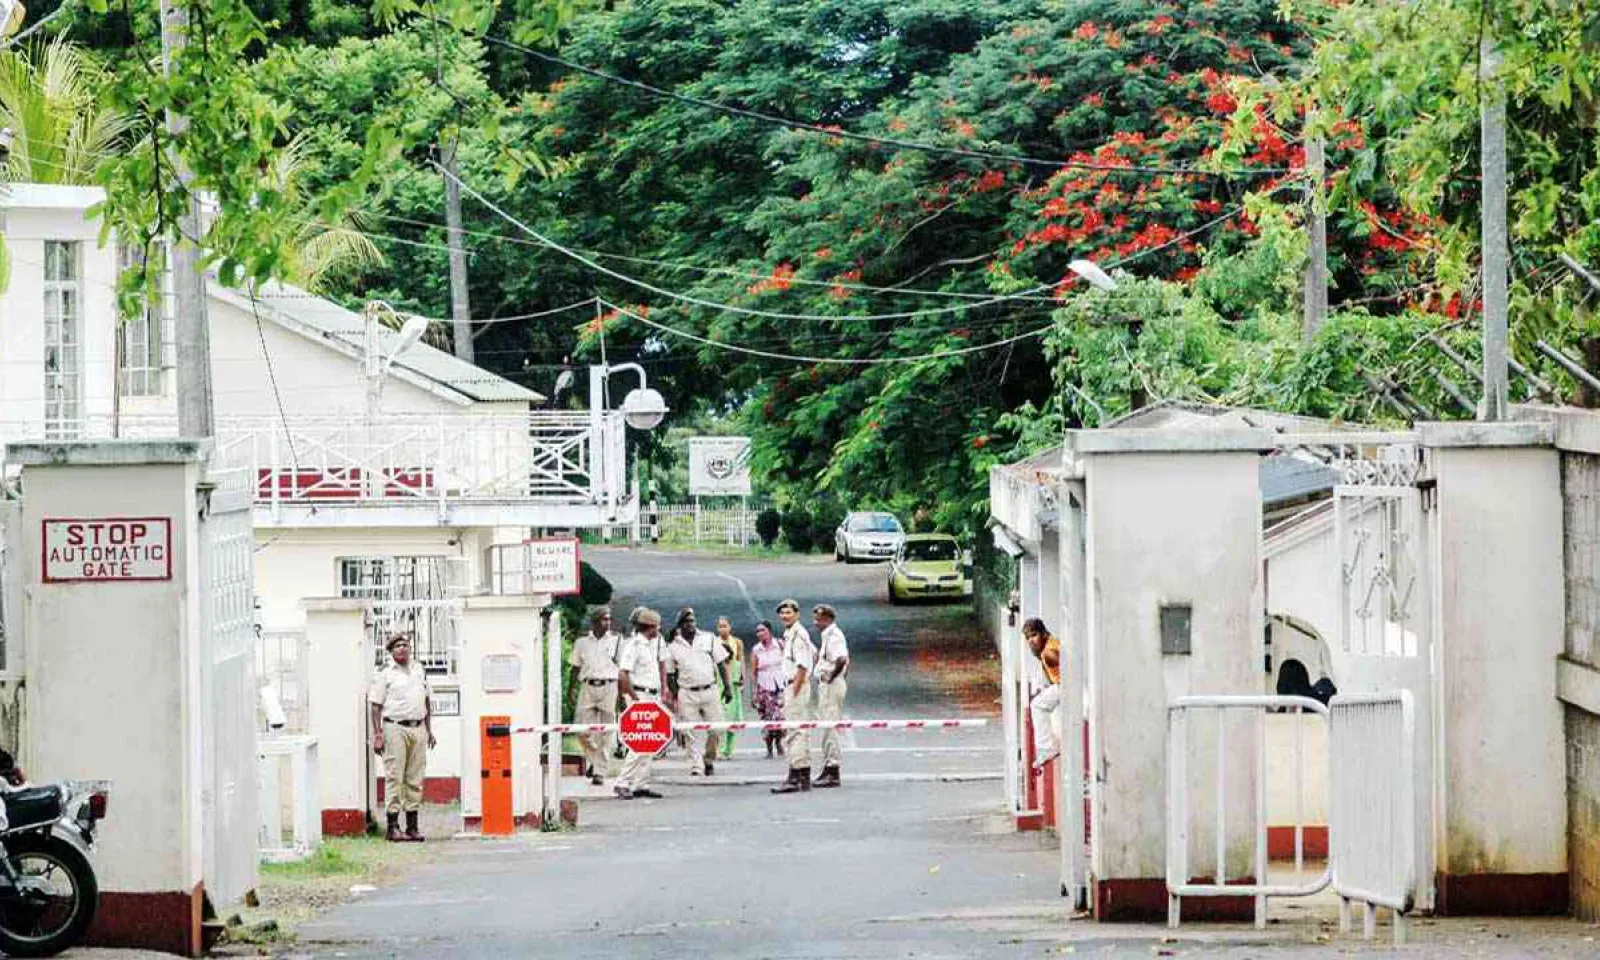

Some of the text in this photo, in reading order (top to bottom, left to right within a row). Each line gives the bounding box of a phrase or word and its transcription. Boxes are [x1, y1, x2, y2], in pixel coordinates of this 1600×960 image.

[67, 524, 147, 545] STOP
[50, 546, 163, 562] AUTOMATIC
[83, 562, 132, 577] GATE
[630, 711, 660, 721] STOP
[636, 722, 653, 730] FOR
[621, 731, 668, 741] CONTROL
